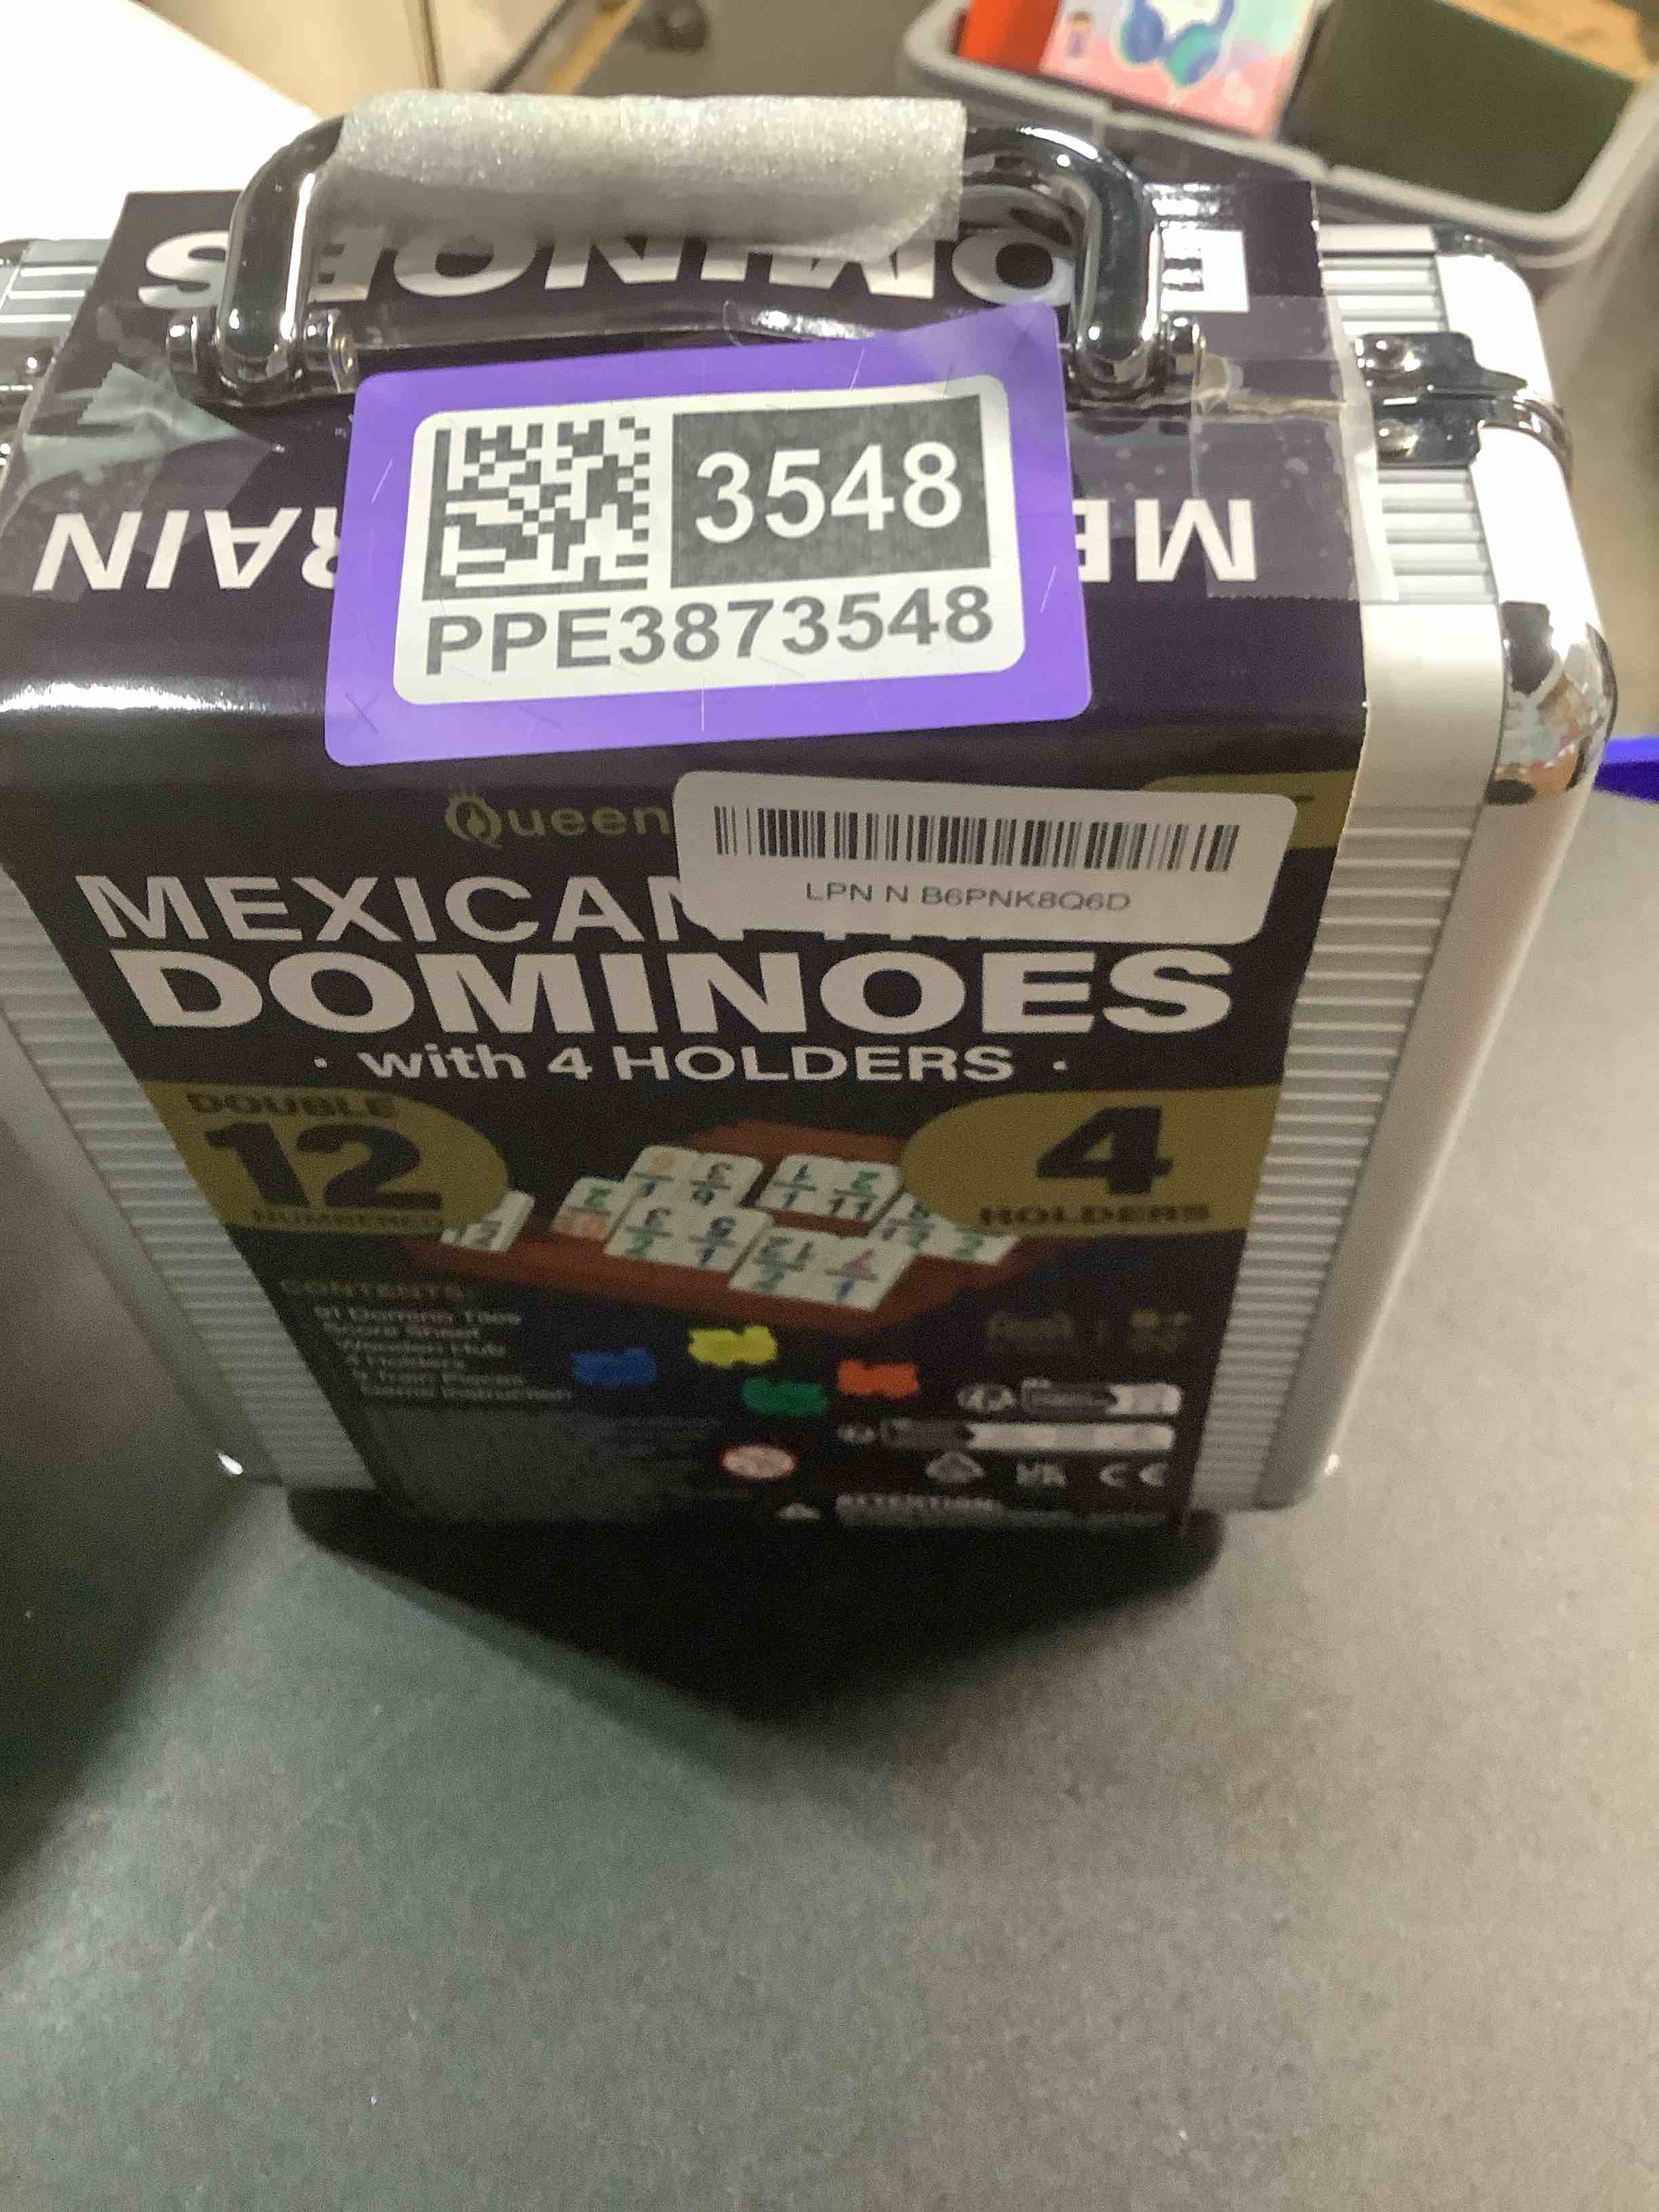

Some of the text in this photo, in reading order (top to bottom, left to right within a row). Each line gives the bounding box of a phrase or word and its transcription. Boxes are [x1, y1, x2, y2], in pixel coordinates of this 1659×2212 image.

[695, 441, 962, 544] 3548
[425, 585, 993, 675] PPE3873548
[806, 882, 873, 902] LPN
[111, 949, 1231, 1034] DOMINOES
[186, 1092, 400, 1119] DOUBLE
[359, 1044, 1014, 1082] with 4 HOLDERS
[204, 1122, 444, 1211] 12
[1034, 1105, 1174, 1197] 4
[979, 1204, 1211, 1226] HOLDERS
